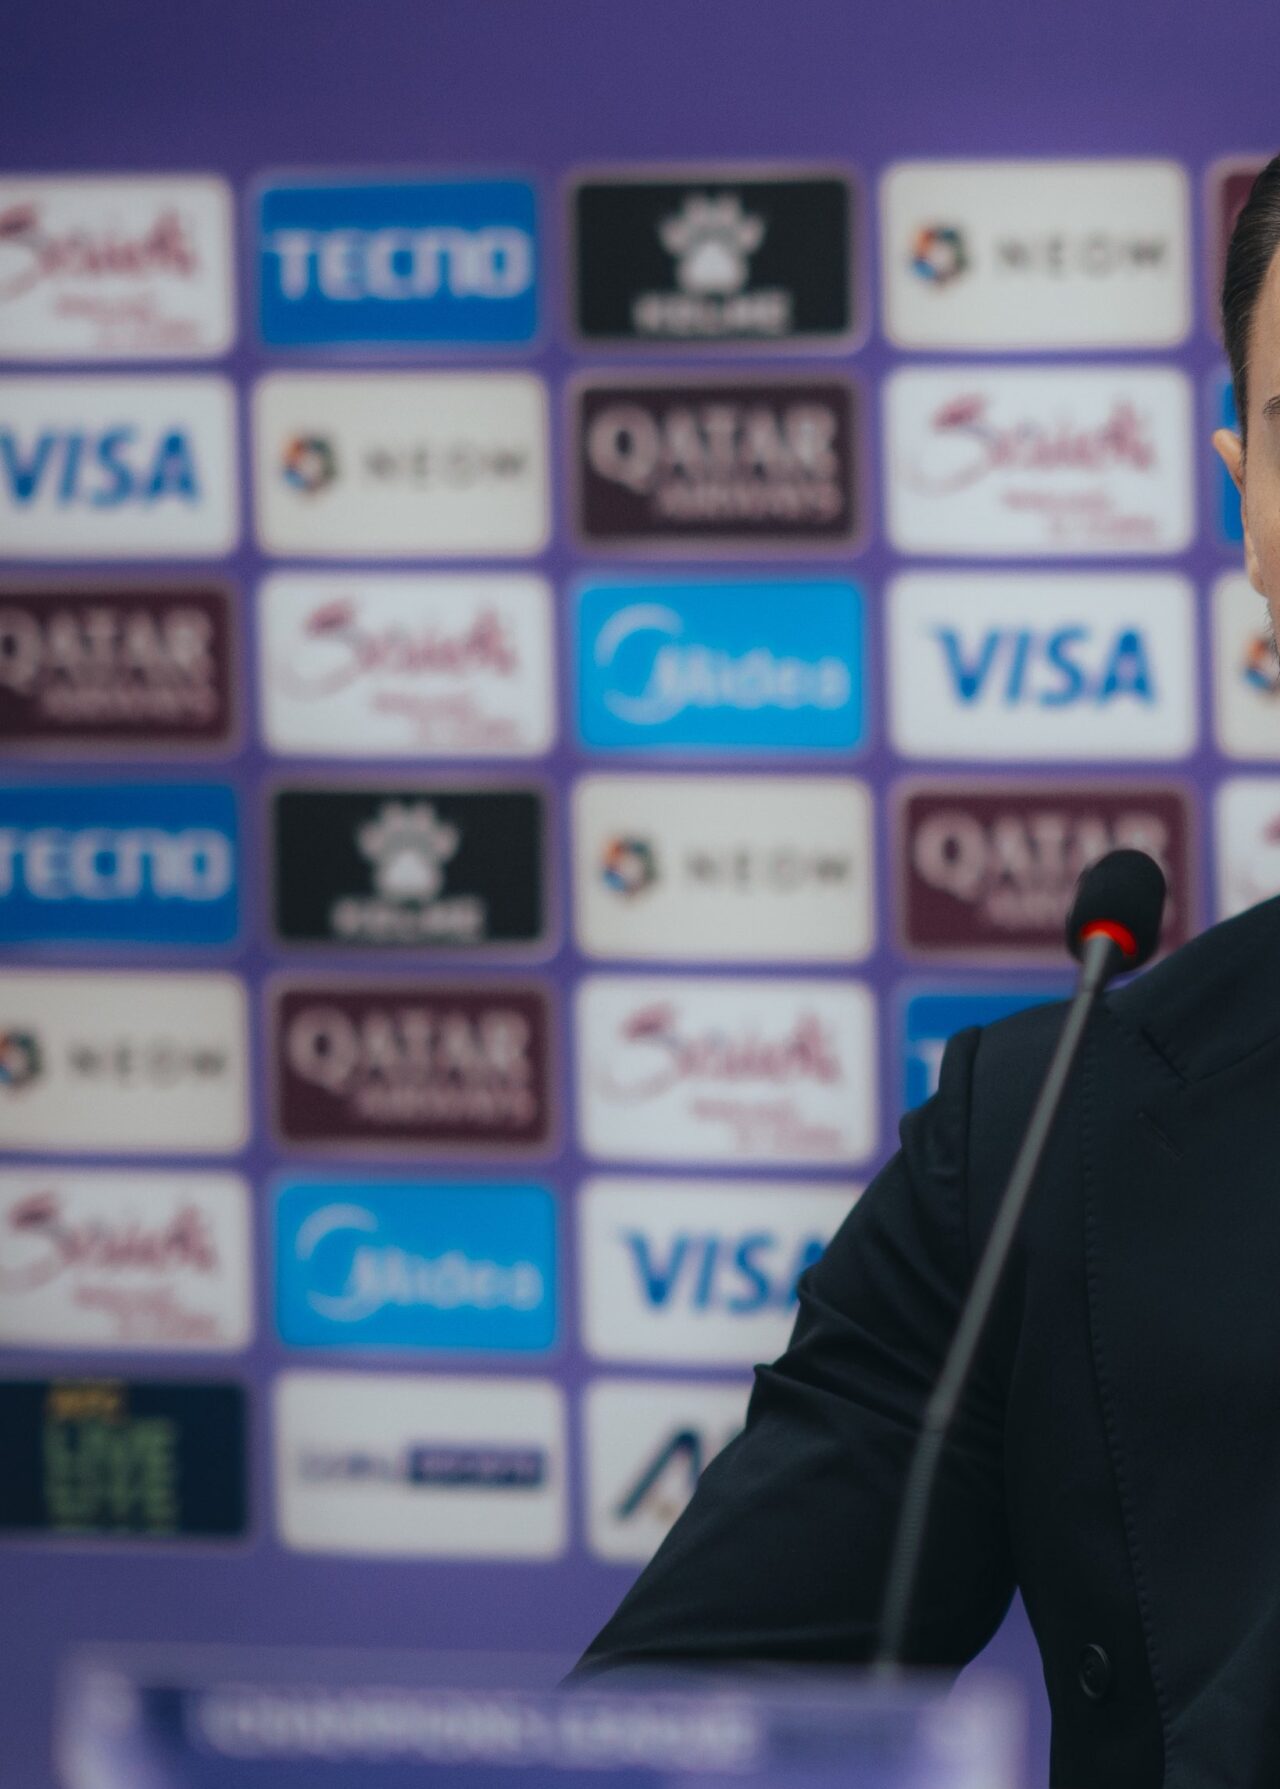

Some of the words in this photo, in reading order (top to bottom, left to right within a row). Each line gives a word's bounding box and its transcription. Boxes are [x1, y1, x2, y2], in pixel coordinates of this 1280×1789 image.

[268, 225, 534, 300] TECNO
[0, 419, 201, 508] VISA
[588, 404, 839, 495] QATAR
[932, 624, 1157, 710] VISA
[288, 1005, 532, 1096] QATAR
